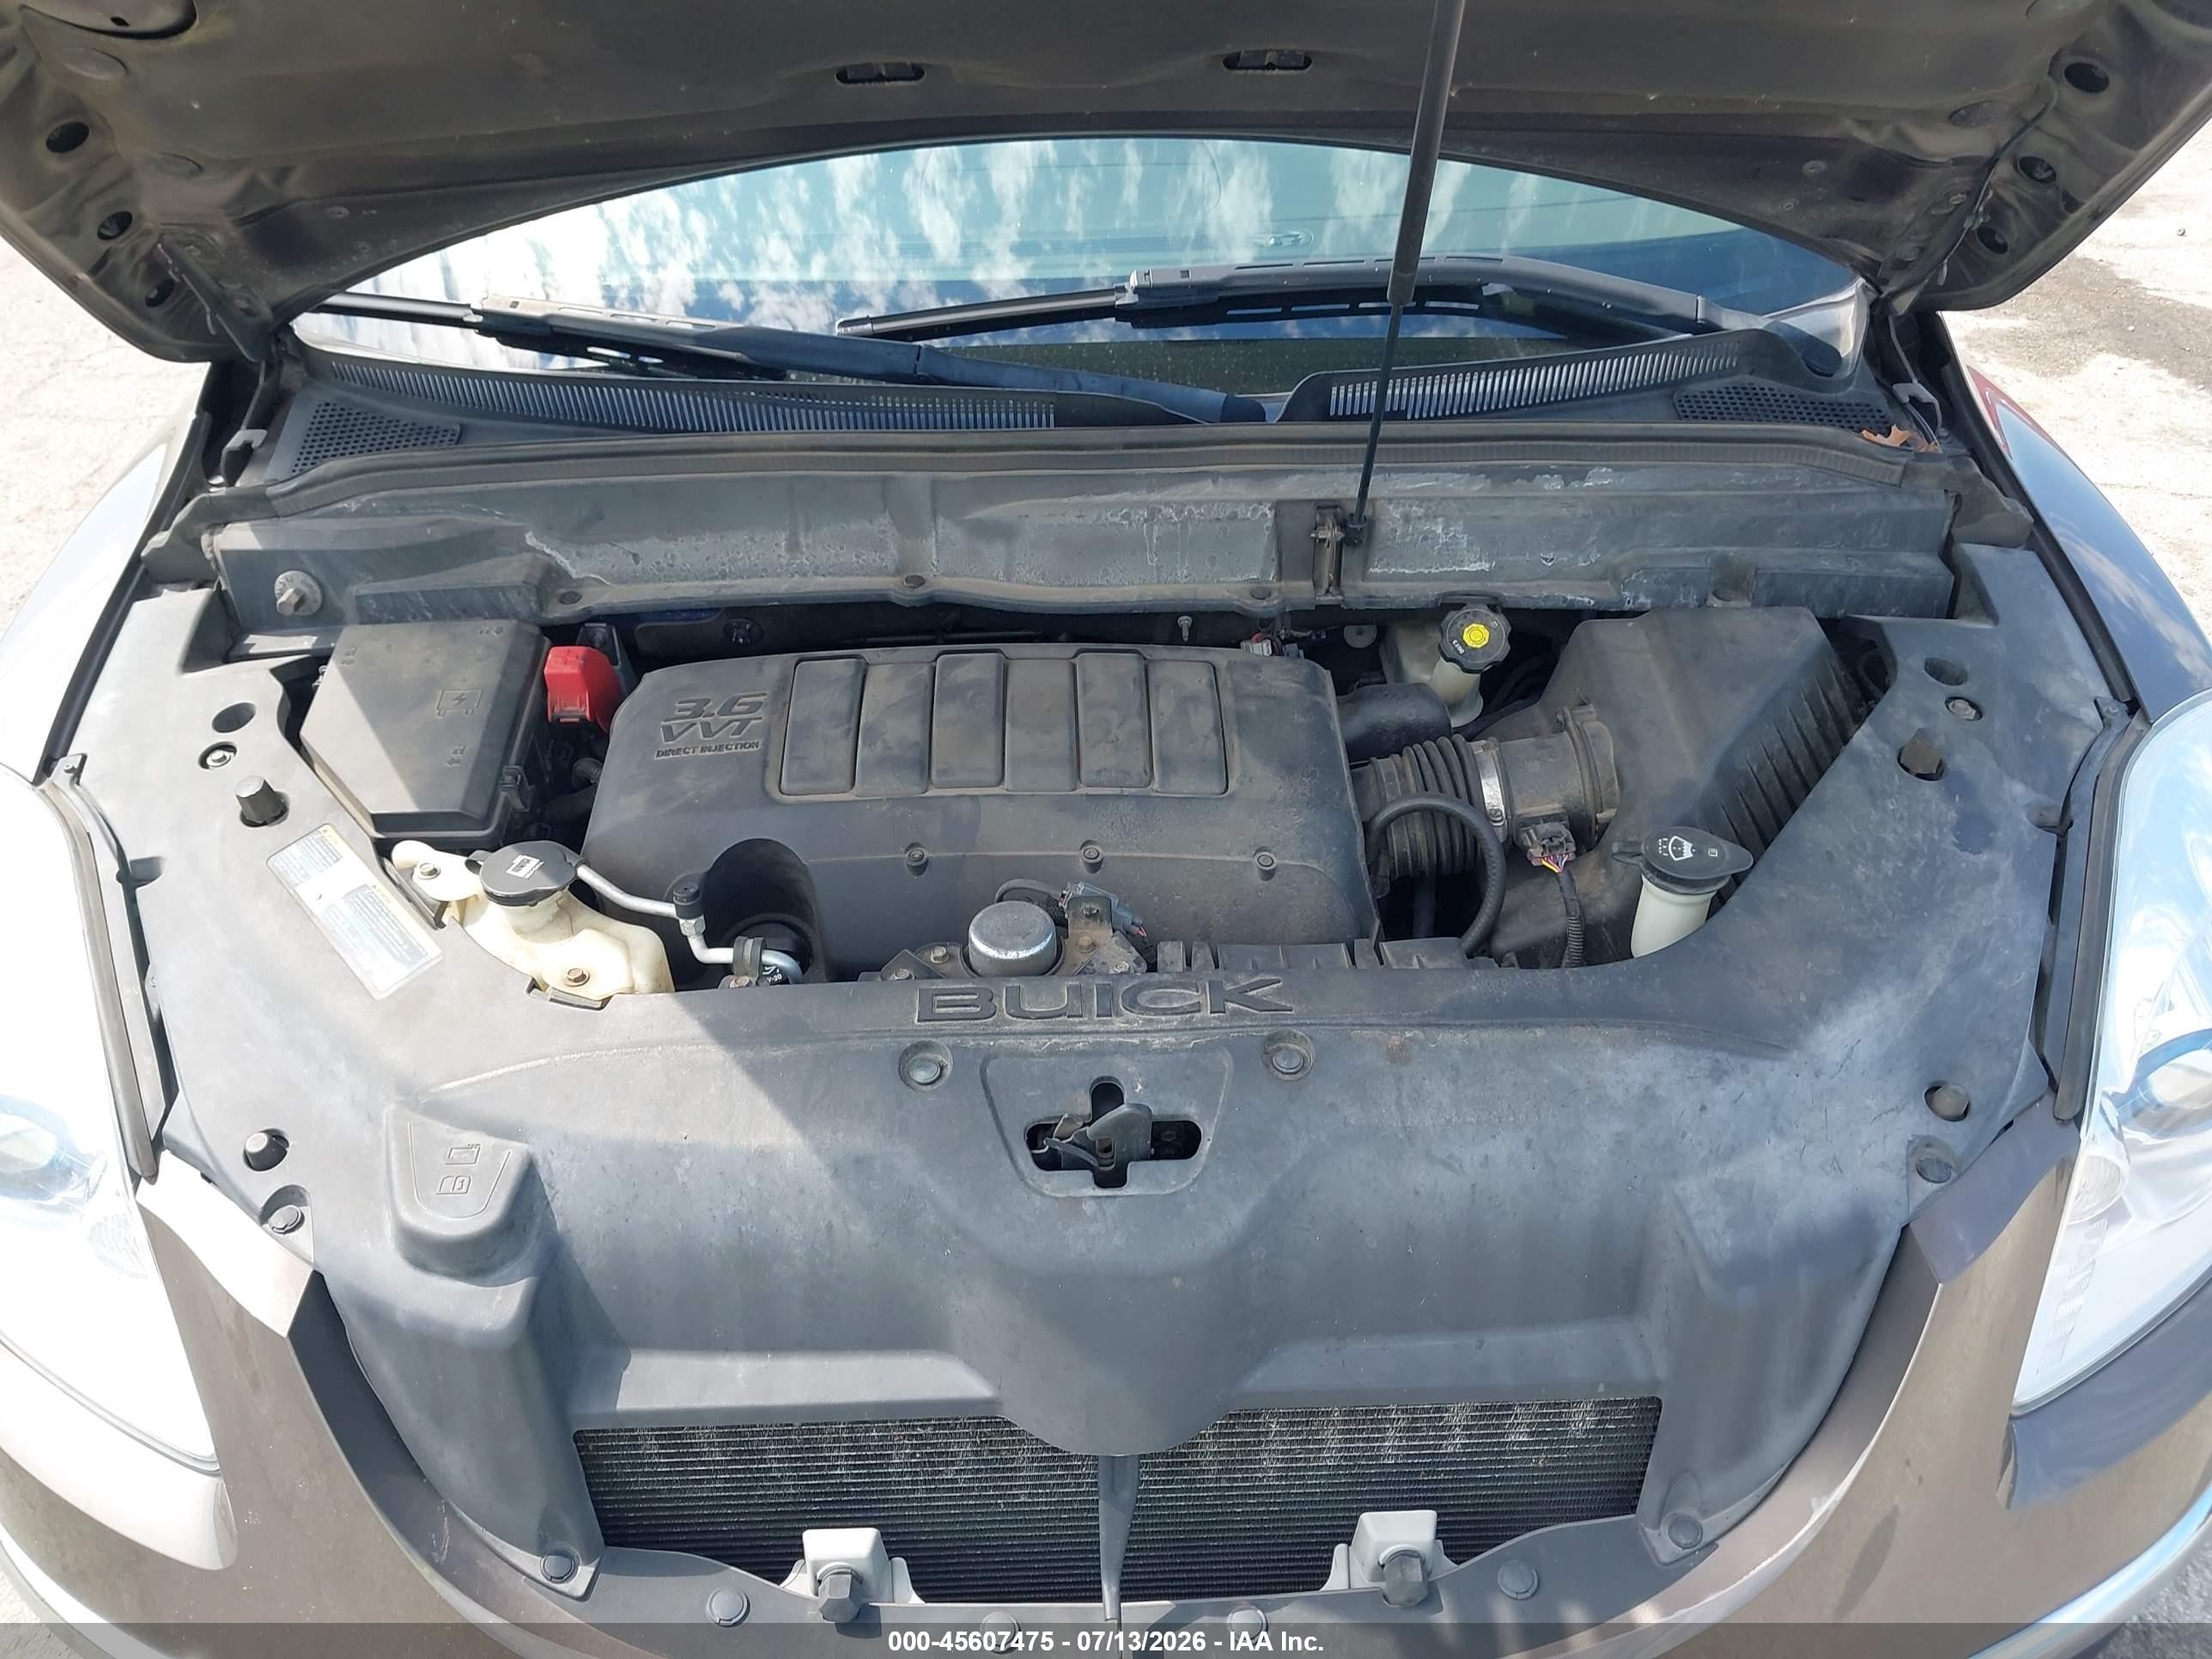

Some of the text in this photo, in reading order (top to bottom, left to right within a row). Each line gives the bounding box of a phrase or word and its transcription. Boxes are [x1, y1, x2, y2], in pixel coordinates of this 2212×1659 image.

[662, 692, 767, 723] 3.6
[660, 716, 763, 744] VVT
[655, 741, 760, 758] DIRECT INJECTION
[917, 977, 1293, 1023] BUICK
